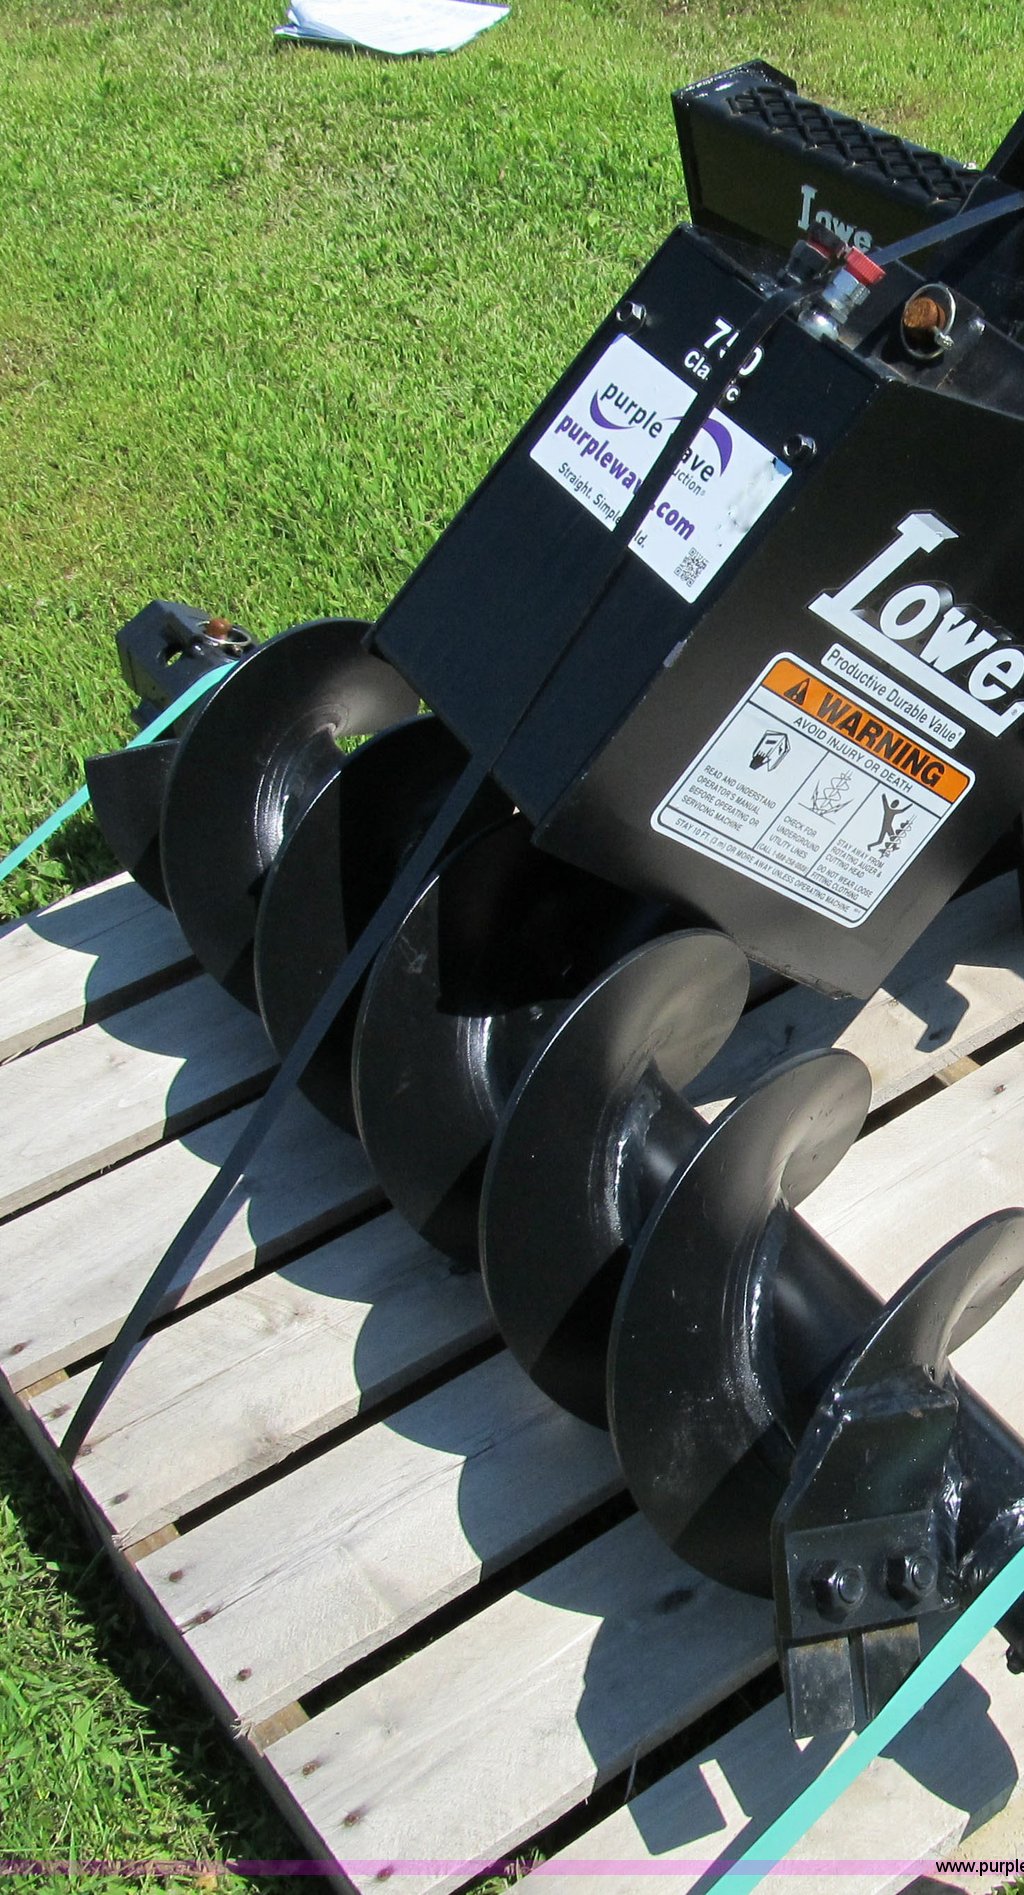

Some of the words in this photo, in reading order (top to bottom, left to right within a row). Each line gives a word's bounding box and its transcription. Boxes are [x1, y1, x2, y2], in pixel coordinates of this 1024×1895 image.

[798, 184, 872, 253] Lowe
[684, 350, 741, 402] Clac
[600, 382, 663, 438] purple
[680, 447, 715, 482] ave
[555, 414, 696, 540] purplewav.com
[673, 467, 702, 497] uction
[558, 462, 592, 499] Straight.
[592, 494, 621, 525] Simple
[634, 529, 645, 549] ld.
[826, 649, 887, 697] Productive
[884, 685, 929, 724] Durable
[794, 716, 827, 741] AVOID
[827, 736, 864, 763] INJURY
[864, 759, 880, 773] OR
[880, 769, 912, 793] DEATH
[817, 692, 945, 787] WARNING
[689, 785, 715, 804] BEFORE
[715, 799, 749, 822] OPERATING
[749, 817, 760, 827] OR
[696, 775, 736, 801] OPERATOR'S
[735, 796, 761, 815] MANUAL
[704, 766, 722, 780] READ
[722, 775, 736, 788] AND
[736, 783, 776, 809] UNDERSTAND
[681, 795, 715, 817] SERVICING
[715, 812, 742, 831] MACHINE
[784, 815, 804, 831] CHECK
[804, 826, 817, 838] FOR
[769, 834, 791, 850] UTILITY
[791, 846, 808, 859] LINES
[776, 825, 820, 853] UNDERGROUND
[837, 839, 850, 850] STAY
[850, 846, 868, 860] AWAY
[868, 856, 884, 868] FROM
[675, 818, 693, 832] STAY
[726, 844, 736, 854] OR
[736, 850, 754, 863] MORE
[754, 859, 772, 872] AWAY
[772, 868, 795, 884] UNLESS
[795, 880, 826, 900] OPERATING
[826, 896, 850, 912] MACHINE
[817, 865, 826, 874] DO
[827, 870, 839, 880] NOT
[838, 876, 855, 889] WEAR
[855, 885, 872, 898] LOOSE
[825, 854, 849, 871] CUTTING
[849, 867, 864, 879] HEAD
[831, 847, 859, 865] ROTATING
[858, 861, 877, 875] AUGER
[811, 872, 832, 887] FITTING
[832, 883, 858, 901] CLOTHING
